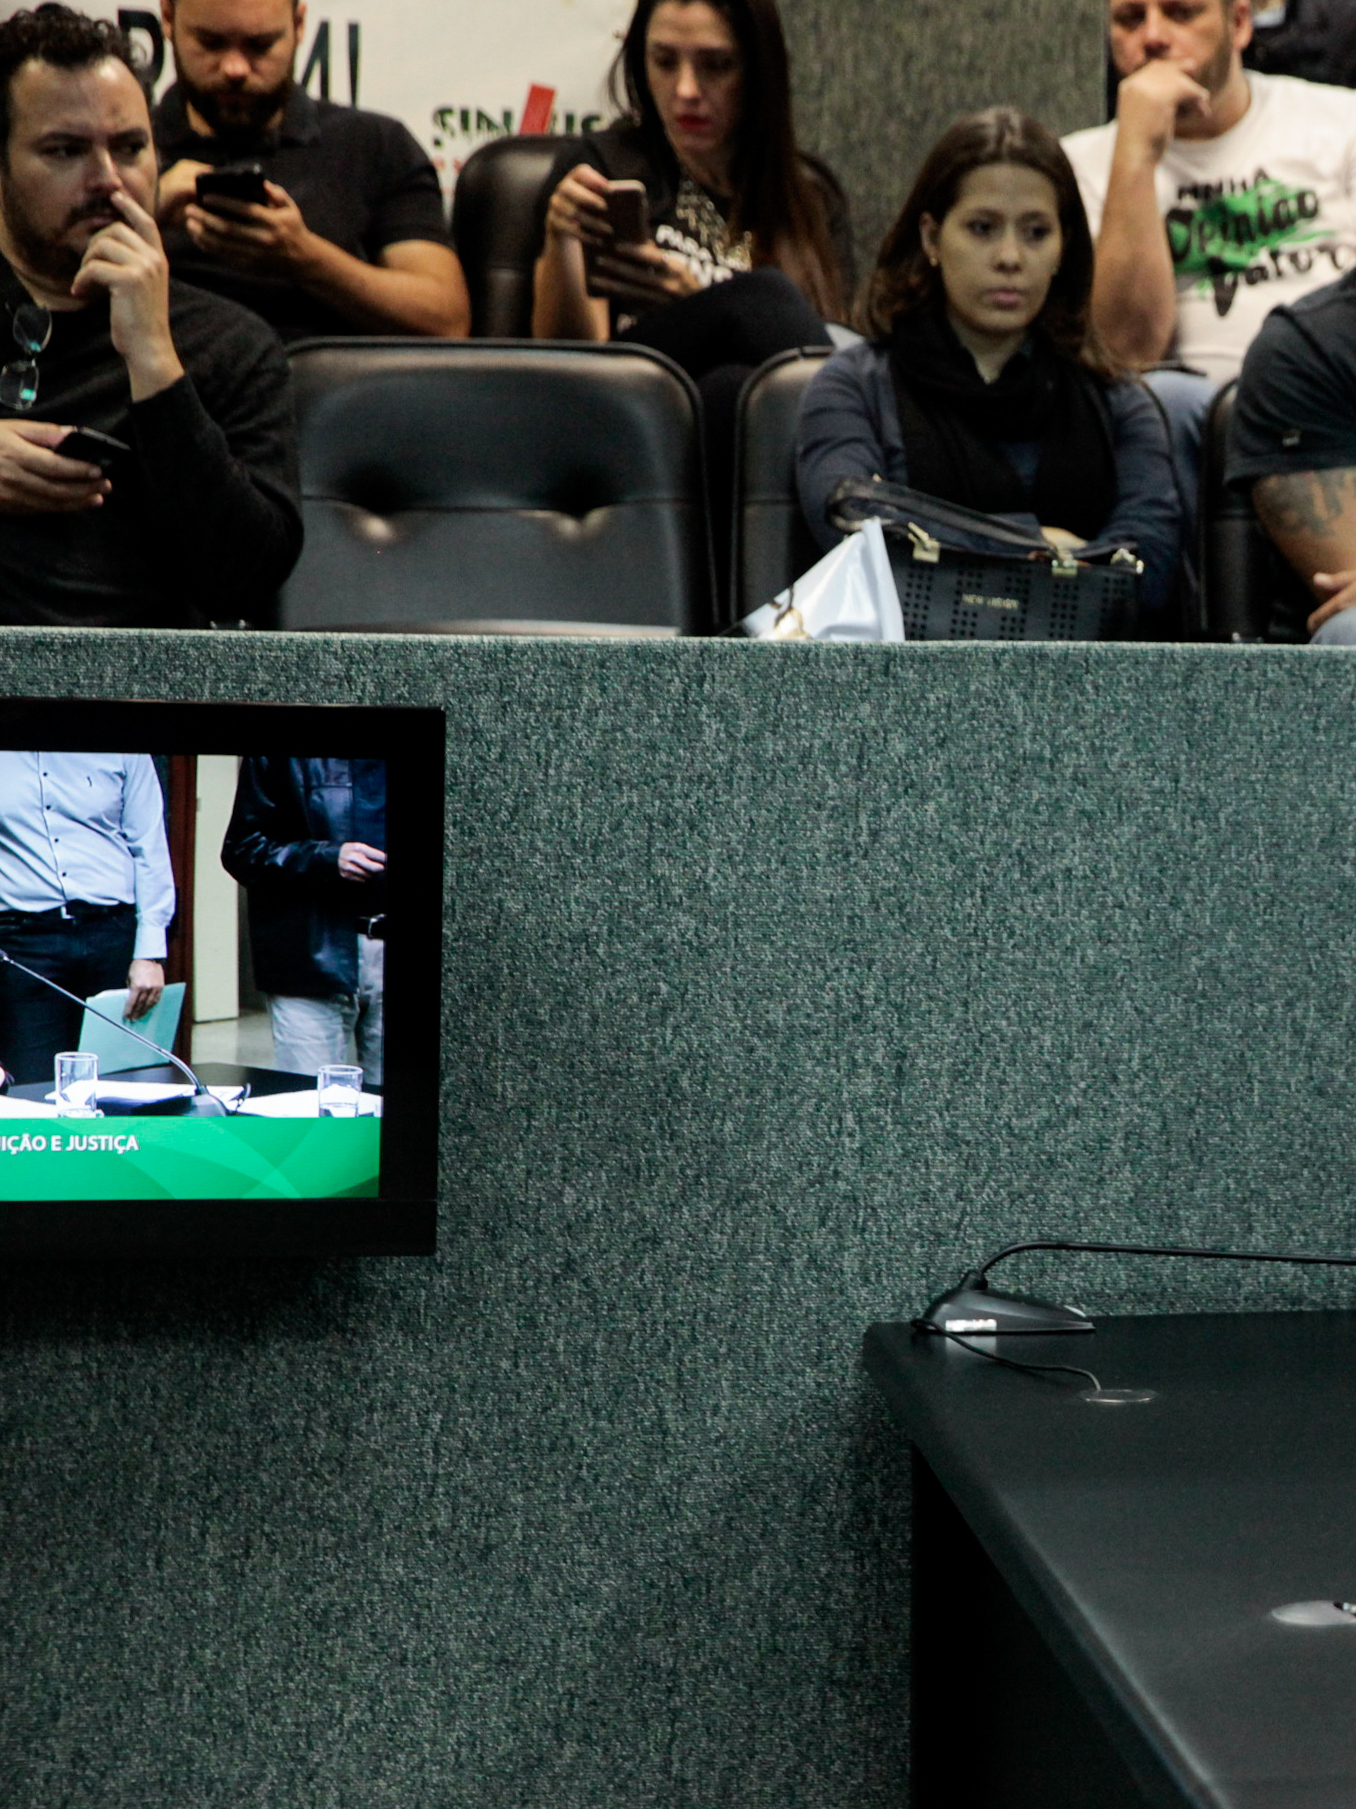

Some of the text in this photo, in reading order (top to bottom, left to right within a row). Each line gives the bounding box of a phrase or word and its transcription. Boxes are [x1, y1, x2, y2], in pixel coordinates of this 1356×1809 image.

[0, 1133, 139, 1155] IÇÃO E JUSTIÇA
